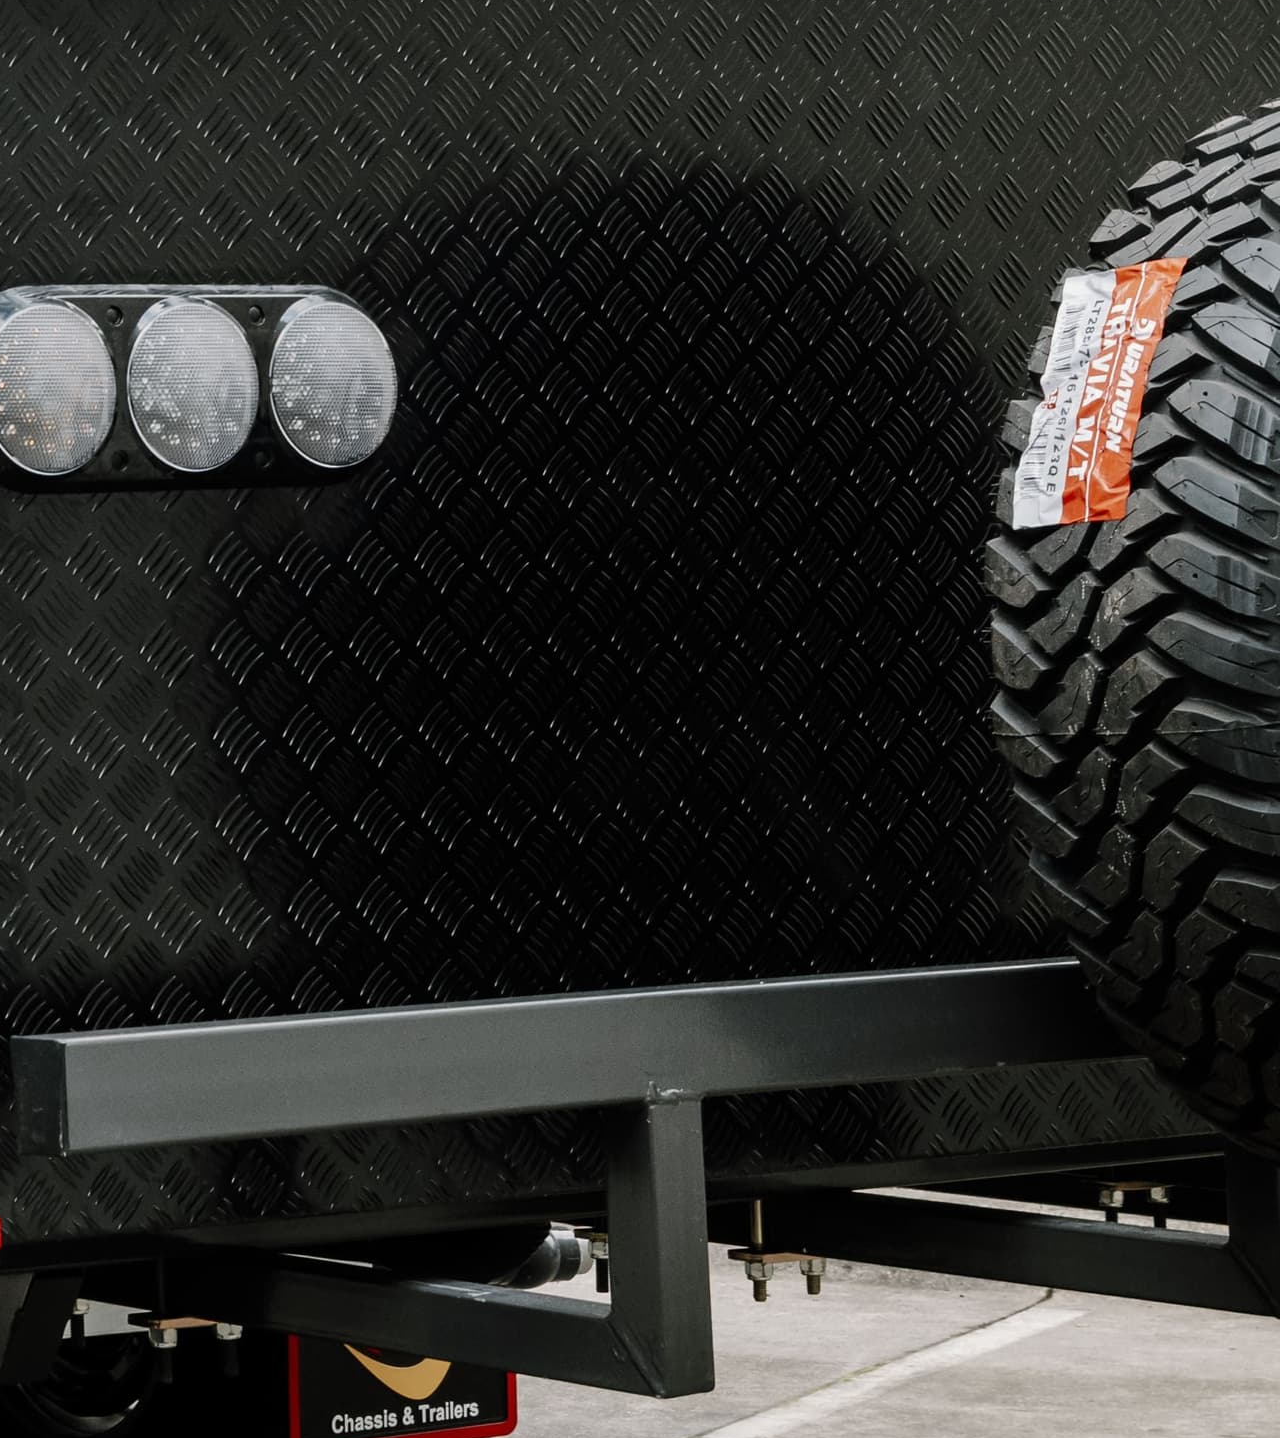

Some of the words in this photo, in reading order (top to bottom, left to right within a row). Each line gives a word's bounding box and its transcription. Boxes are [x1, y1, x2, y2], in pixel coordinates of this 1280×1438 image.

[1082, 296, 1133, 408] TRAVIA
[1105, 318, 1154, 453] DURATURN
[1068, 415, 1095, 481] M/T
[331, 1409, 398, 1435] Chassis
[402, 1406, 415, 1426] &
[419, 1401, 480, 1424] Trailers
